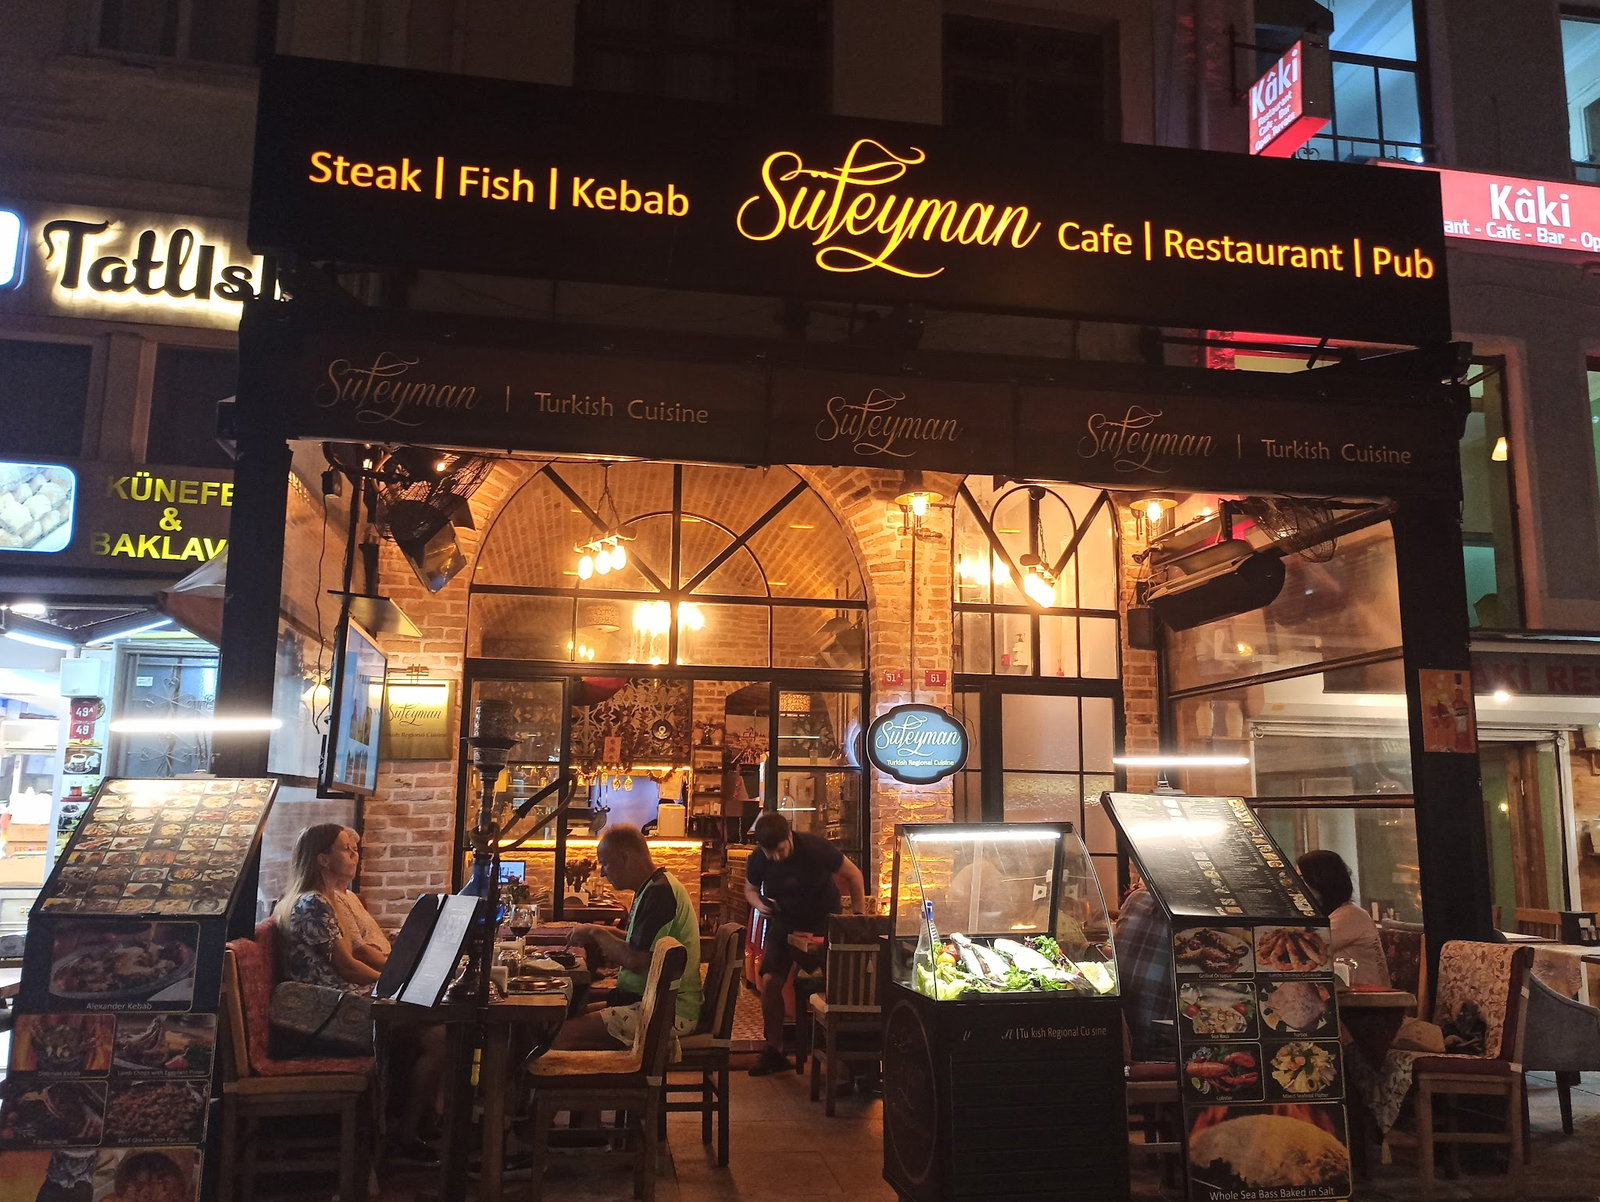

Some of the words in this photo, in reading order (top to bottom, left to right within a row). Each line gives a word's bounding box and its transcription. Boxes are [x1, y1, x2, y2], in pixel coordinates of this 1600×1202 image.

[308, 150, 422, 193] Steak
[459, 166, 535, 203] Fish
[572, 176, 690, 217] Kebab
[1057, 221, 1133, 256] Cafe
[1164, 228, 1344, 272] Restaurant
[1373, 246, 1434, 280] Pub
[1489, 183, 1571, 228] Kâki
[1485, 221, 1521, 240] Cafe
[1536, 226, 1566, 245] Bar
[534, 391, 614, 417] Turkish
[627, 400, 709, 425] Cuisine
[1261, 438, 1331, 461] Turkish
[1341, 443, 1412, 465] Cuisine
[159, 507, 183, 532] &
[909, 759, 933, 767] Regional
[86, 1002, 125, 1010] Alexander
[127, 1002, 152, 1010] Kebab
[1047, 1026, 1079, 1039] Regional
[1209, 1191, 1239, 1201] Whole
[1240, 1190, 1256, 1200] Sea
[1258, 1189, 1279, 1199] Bass
[1280, 1188, 1307, 1198] Baked
[1308, 1188, 1317, 1196] in
[1318, 1186, 1335, 1196] Salt
